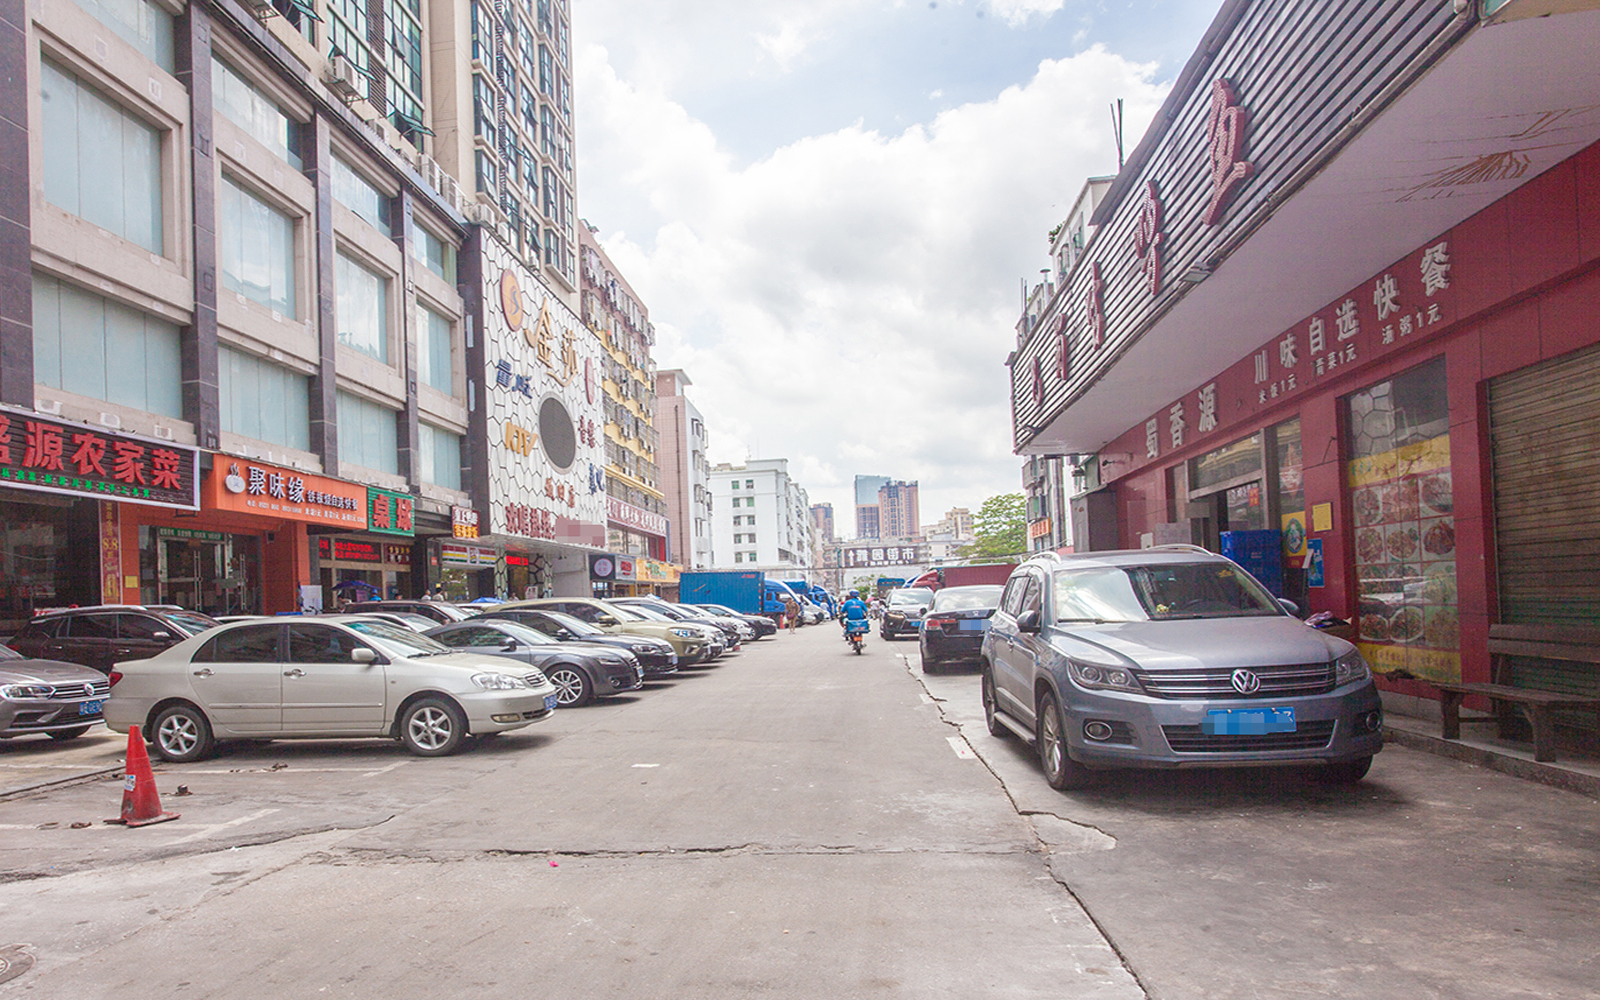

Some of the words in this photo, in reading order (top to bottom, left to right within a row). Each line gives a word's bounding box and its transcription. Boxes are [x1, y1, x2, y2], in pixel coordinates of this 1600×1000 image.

[1145, 382, 1219, 459] 蜀香源
[1253, 240, 1453, 385] 川味自选快餐
[504, 421, 539, 457] KTV
[247, 465, 306, 504] 聚味缘
[372, 494, 413, 531] 桌球
